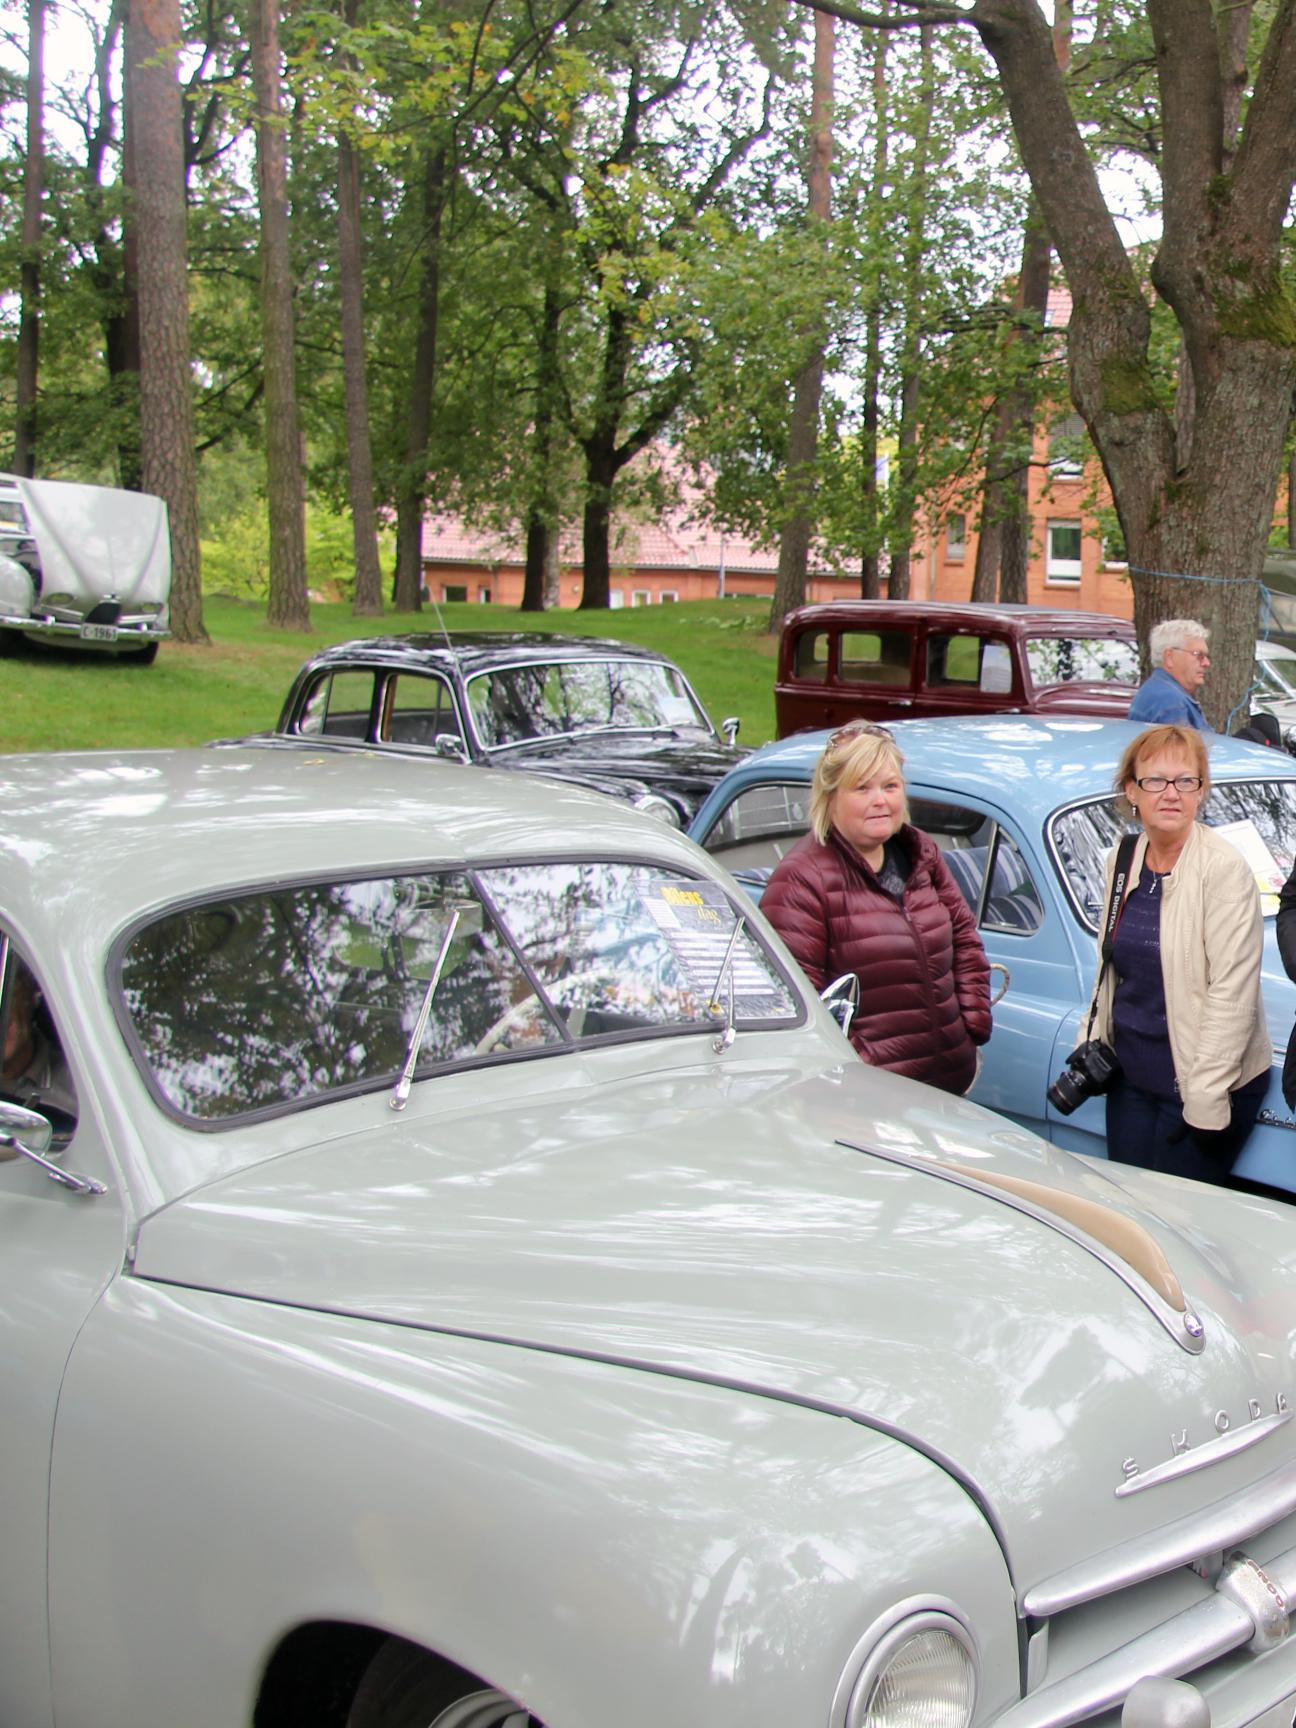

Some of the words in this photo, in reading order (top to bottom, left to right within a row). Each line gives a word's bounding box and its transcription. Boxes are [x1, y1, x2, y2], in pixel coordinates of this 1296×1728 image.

[1116, 873, 1125, 893] EOS
[1108, 896, 1120, 932] DIGITAL
[1246, 1559, 1285, 1608] 1200
